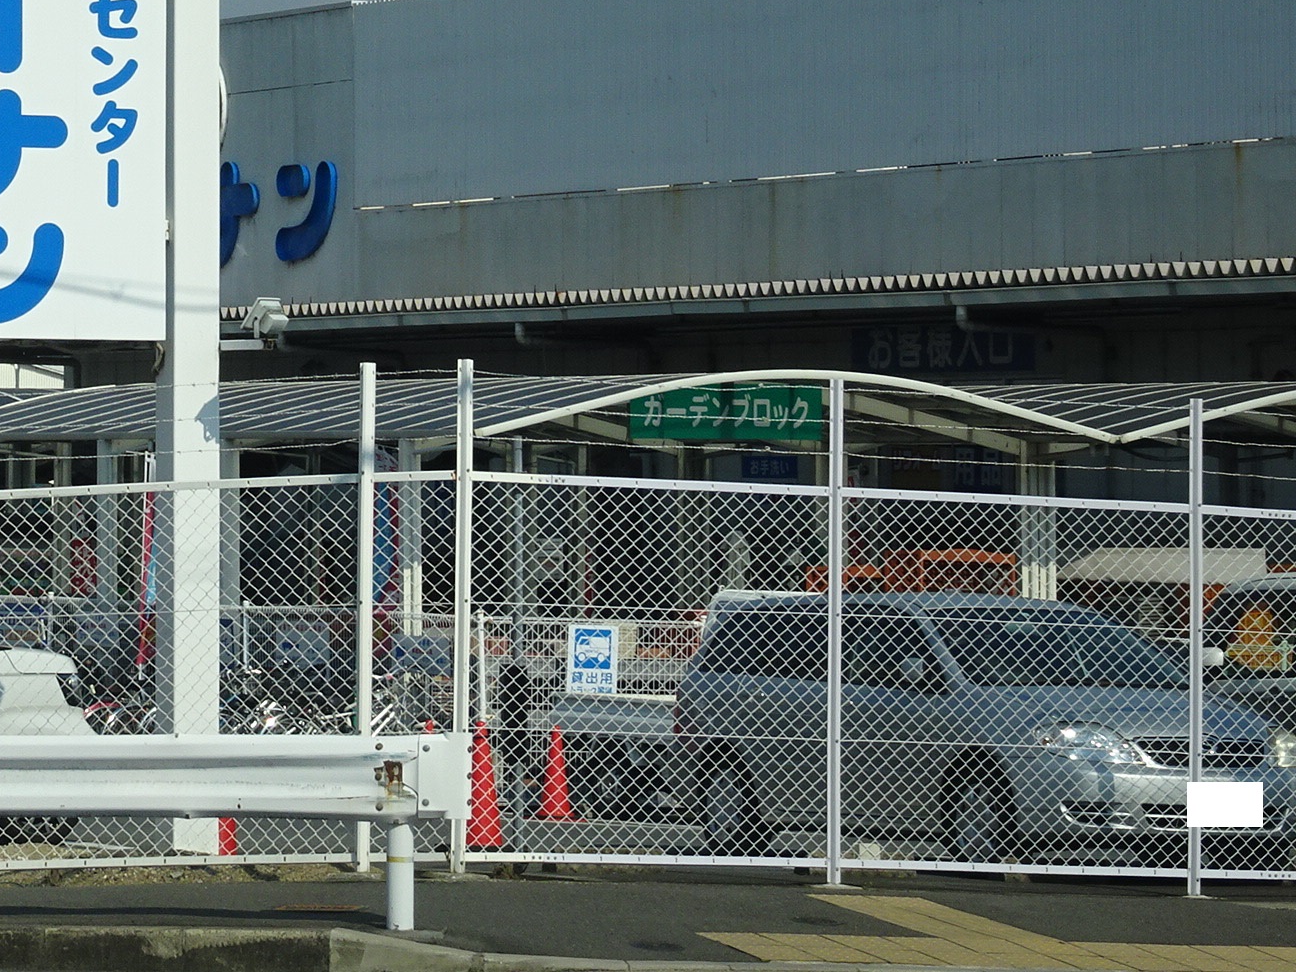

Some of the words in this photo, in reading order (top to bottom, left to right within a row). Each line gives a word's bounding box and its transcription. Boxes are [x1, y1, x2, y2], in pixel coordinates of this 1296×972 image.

[867, 326, 1013, 369] お客様入口
[643, 393, 809, 430] ガーデンブロック
[749, 459, 790, 476] お手洗い
[571, 671, 613, 685] 貸出用
